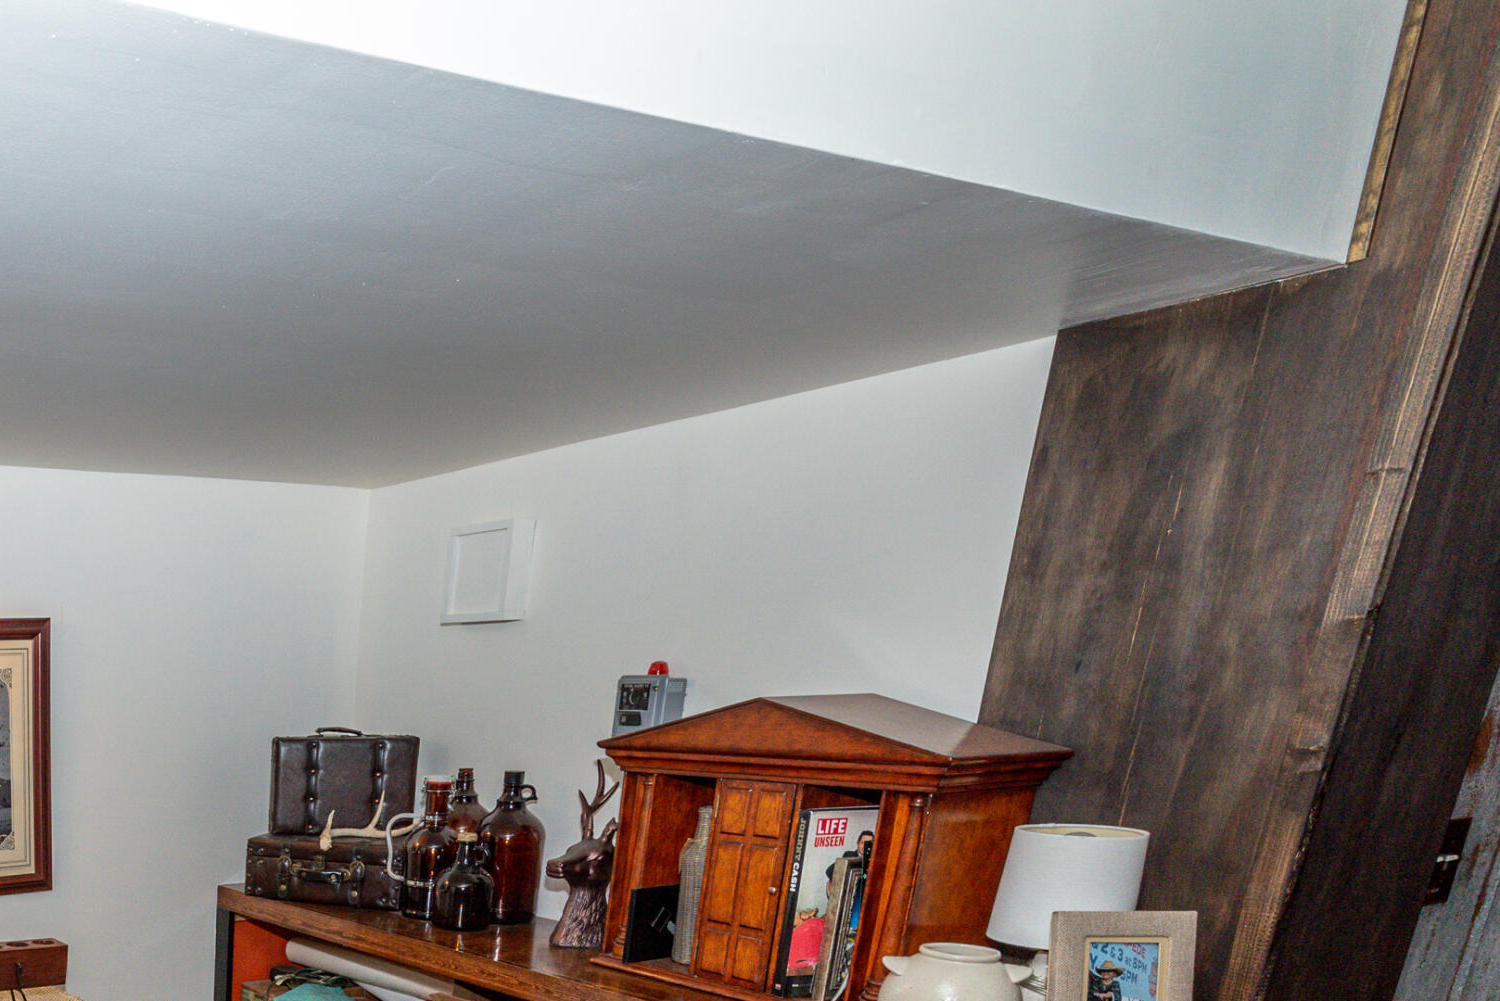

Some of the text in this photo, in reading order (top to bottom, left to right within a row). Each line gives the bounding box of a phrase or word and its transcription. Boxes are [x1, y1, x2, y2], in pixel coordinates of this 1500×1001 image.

[817, 819, 847, 834] LIFE
[814, 836, 845, 848] UNSEEN
[789, 818, 806, 892] JOHNNY CASH
[1101, 943, 1108, 954] 2
[1117, 948, 1124, 962] 3
